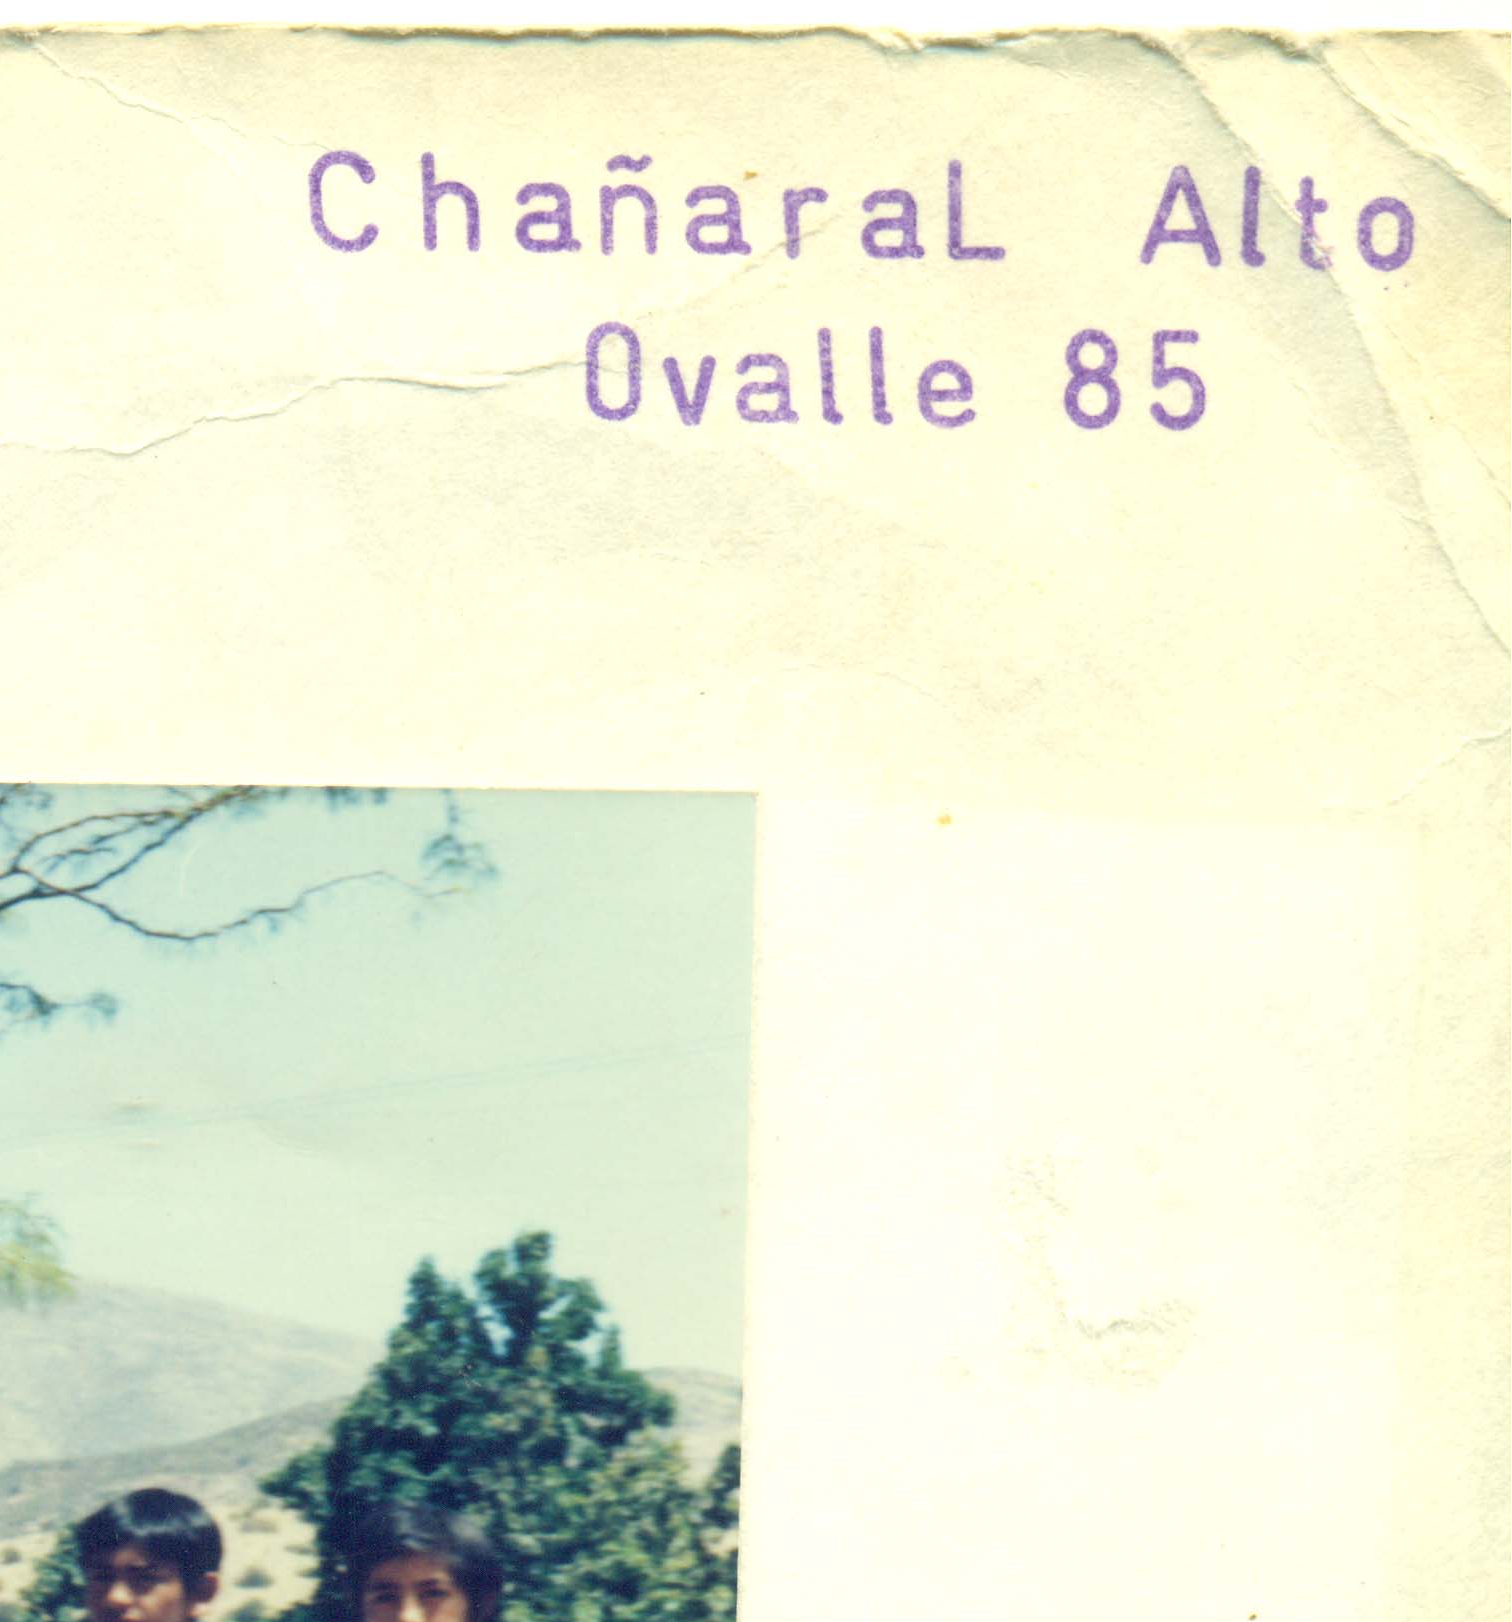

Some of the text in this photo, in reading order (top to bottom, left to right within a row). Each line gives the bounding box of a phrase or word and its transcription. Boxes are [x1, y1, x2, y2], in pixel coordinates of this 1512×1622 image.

[1140, 164, 1416, 273] Alto
[585, 321, 1208, 431] Ovalle 85
